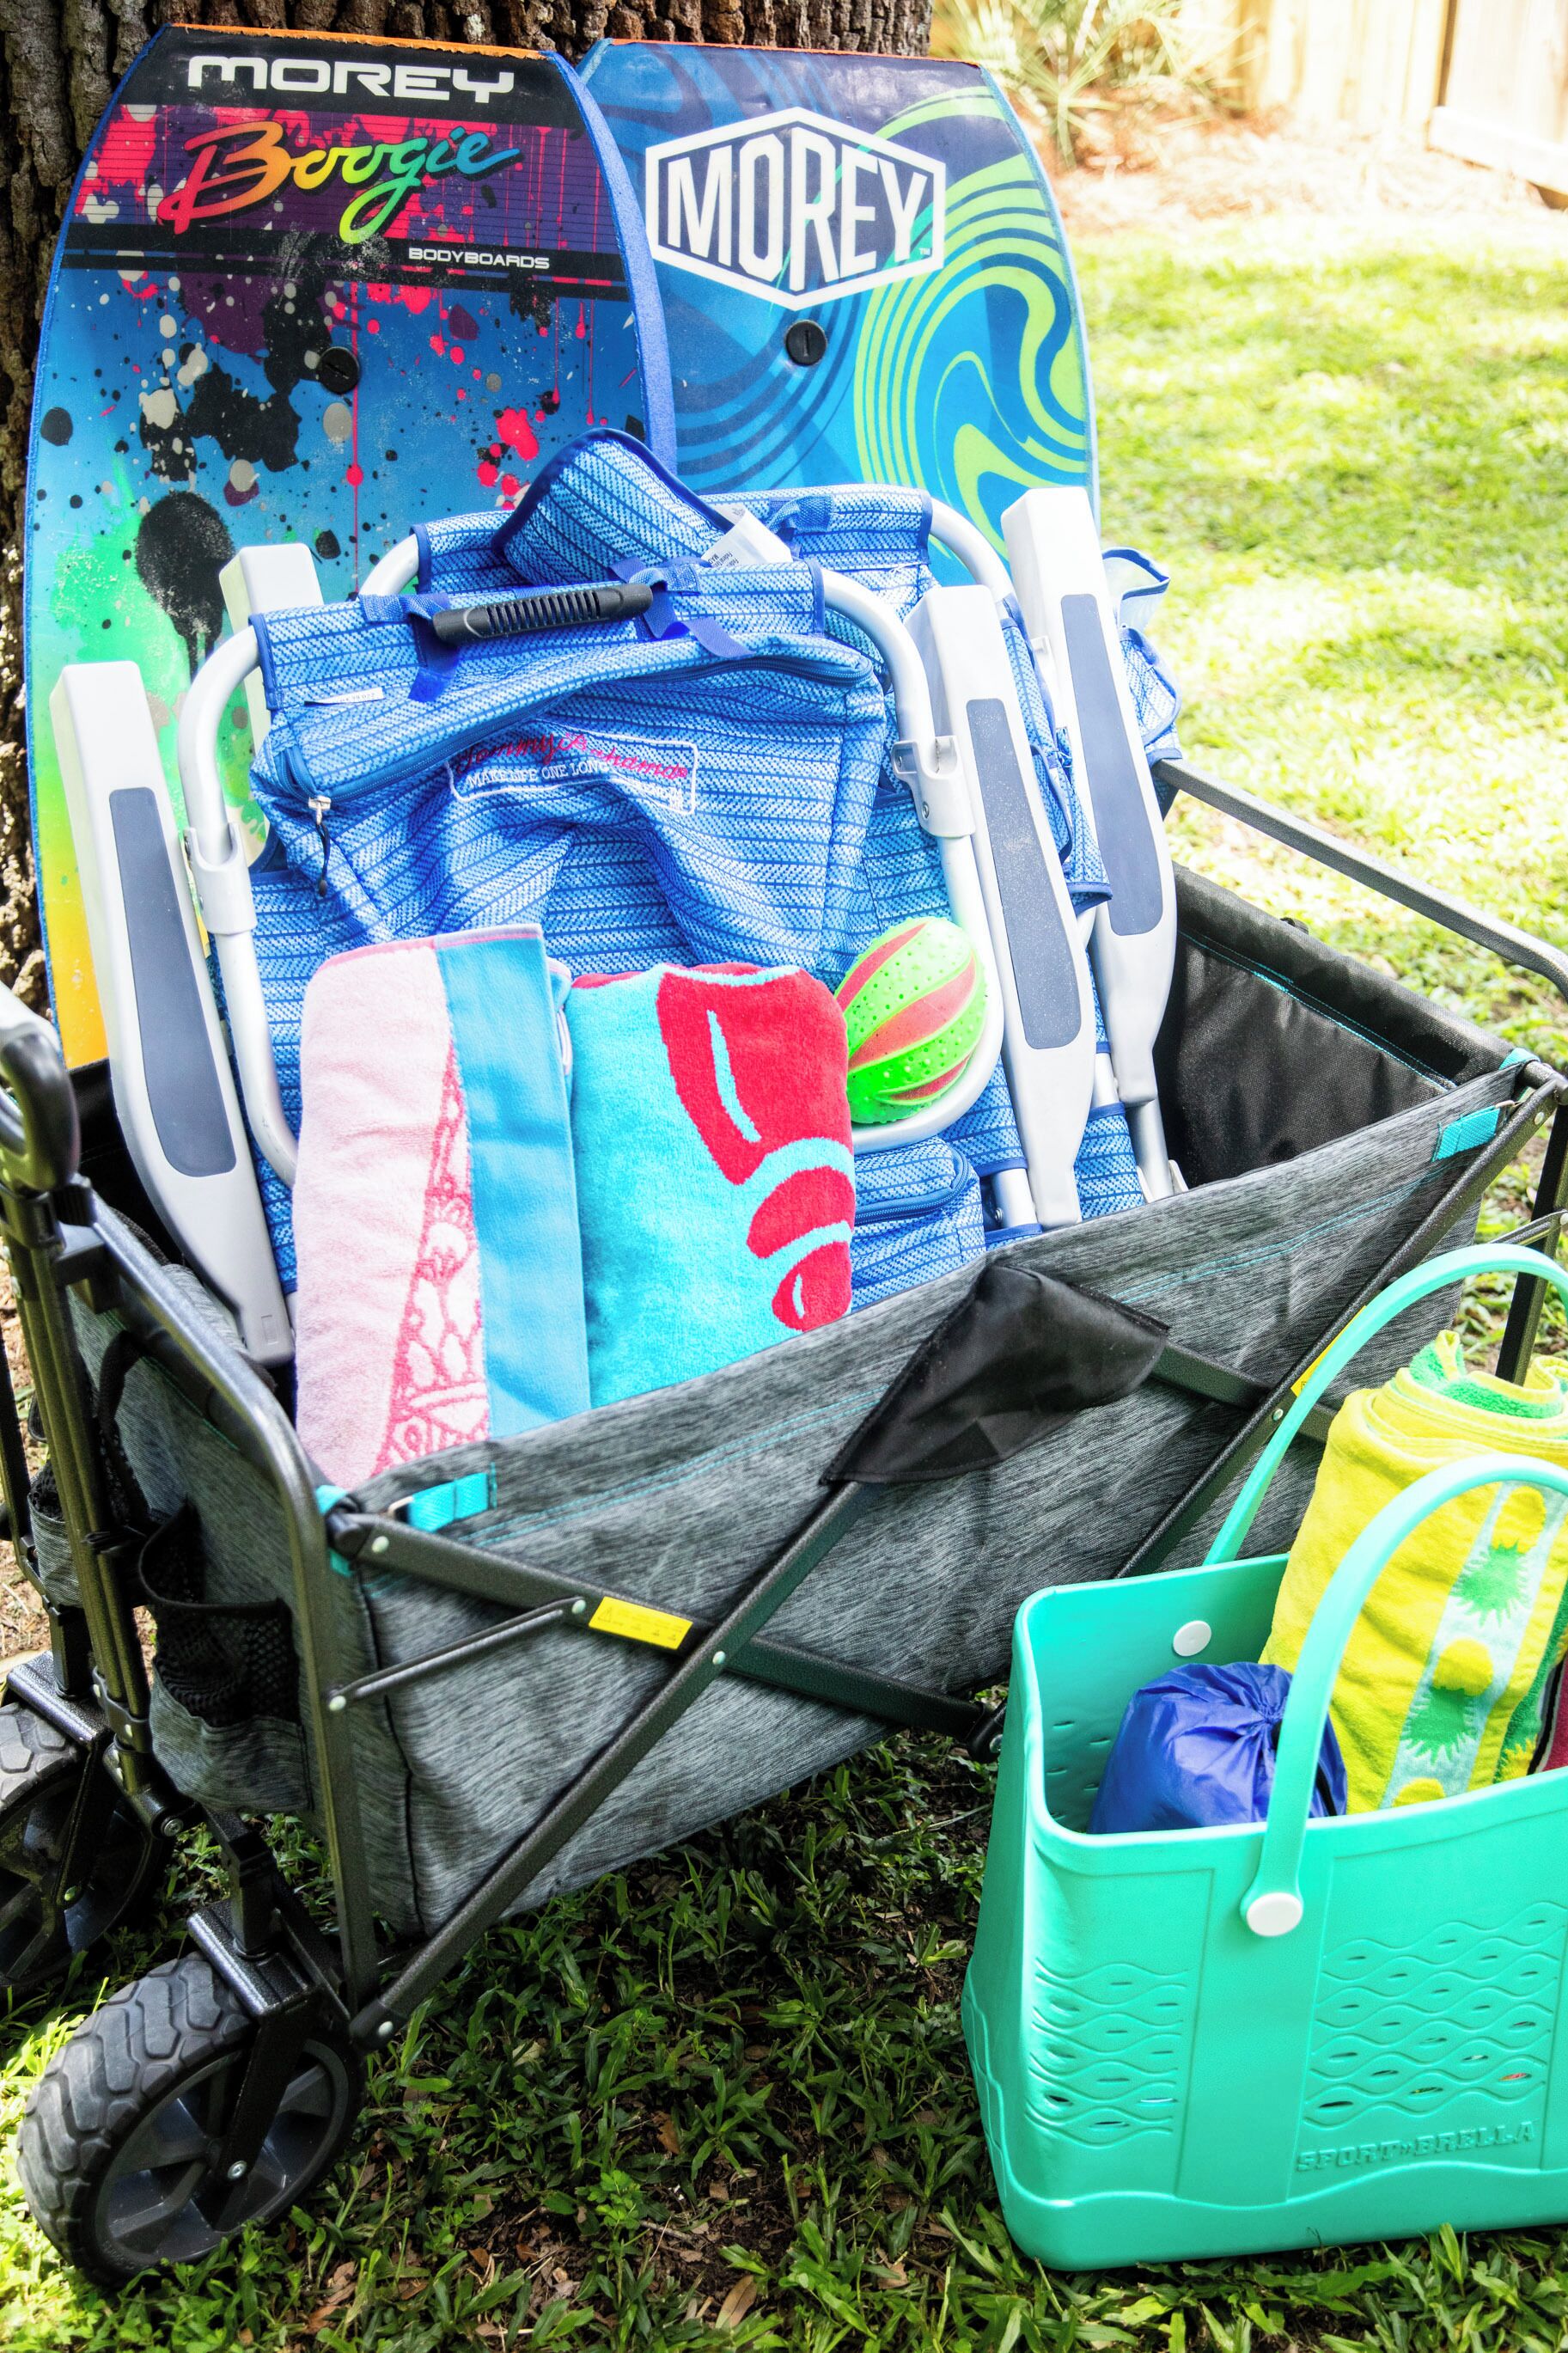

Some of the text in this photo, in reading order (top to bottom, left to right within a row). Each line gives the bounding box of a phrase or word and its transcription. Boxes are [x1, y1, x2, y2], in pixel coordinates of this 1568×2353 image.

[187, 55, 516, 104] MOREY
[157, 121, 522, 243] Boogie
[668, 126, 928, 293] MOREY
[408, 247, 550, 270] BODYBOARDS
[456, 733, 556, 773] Tommy
[466, 760, 610, 788] MAKE LIFE ONE LONG
